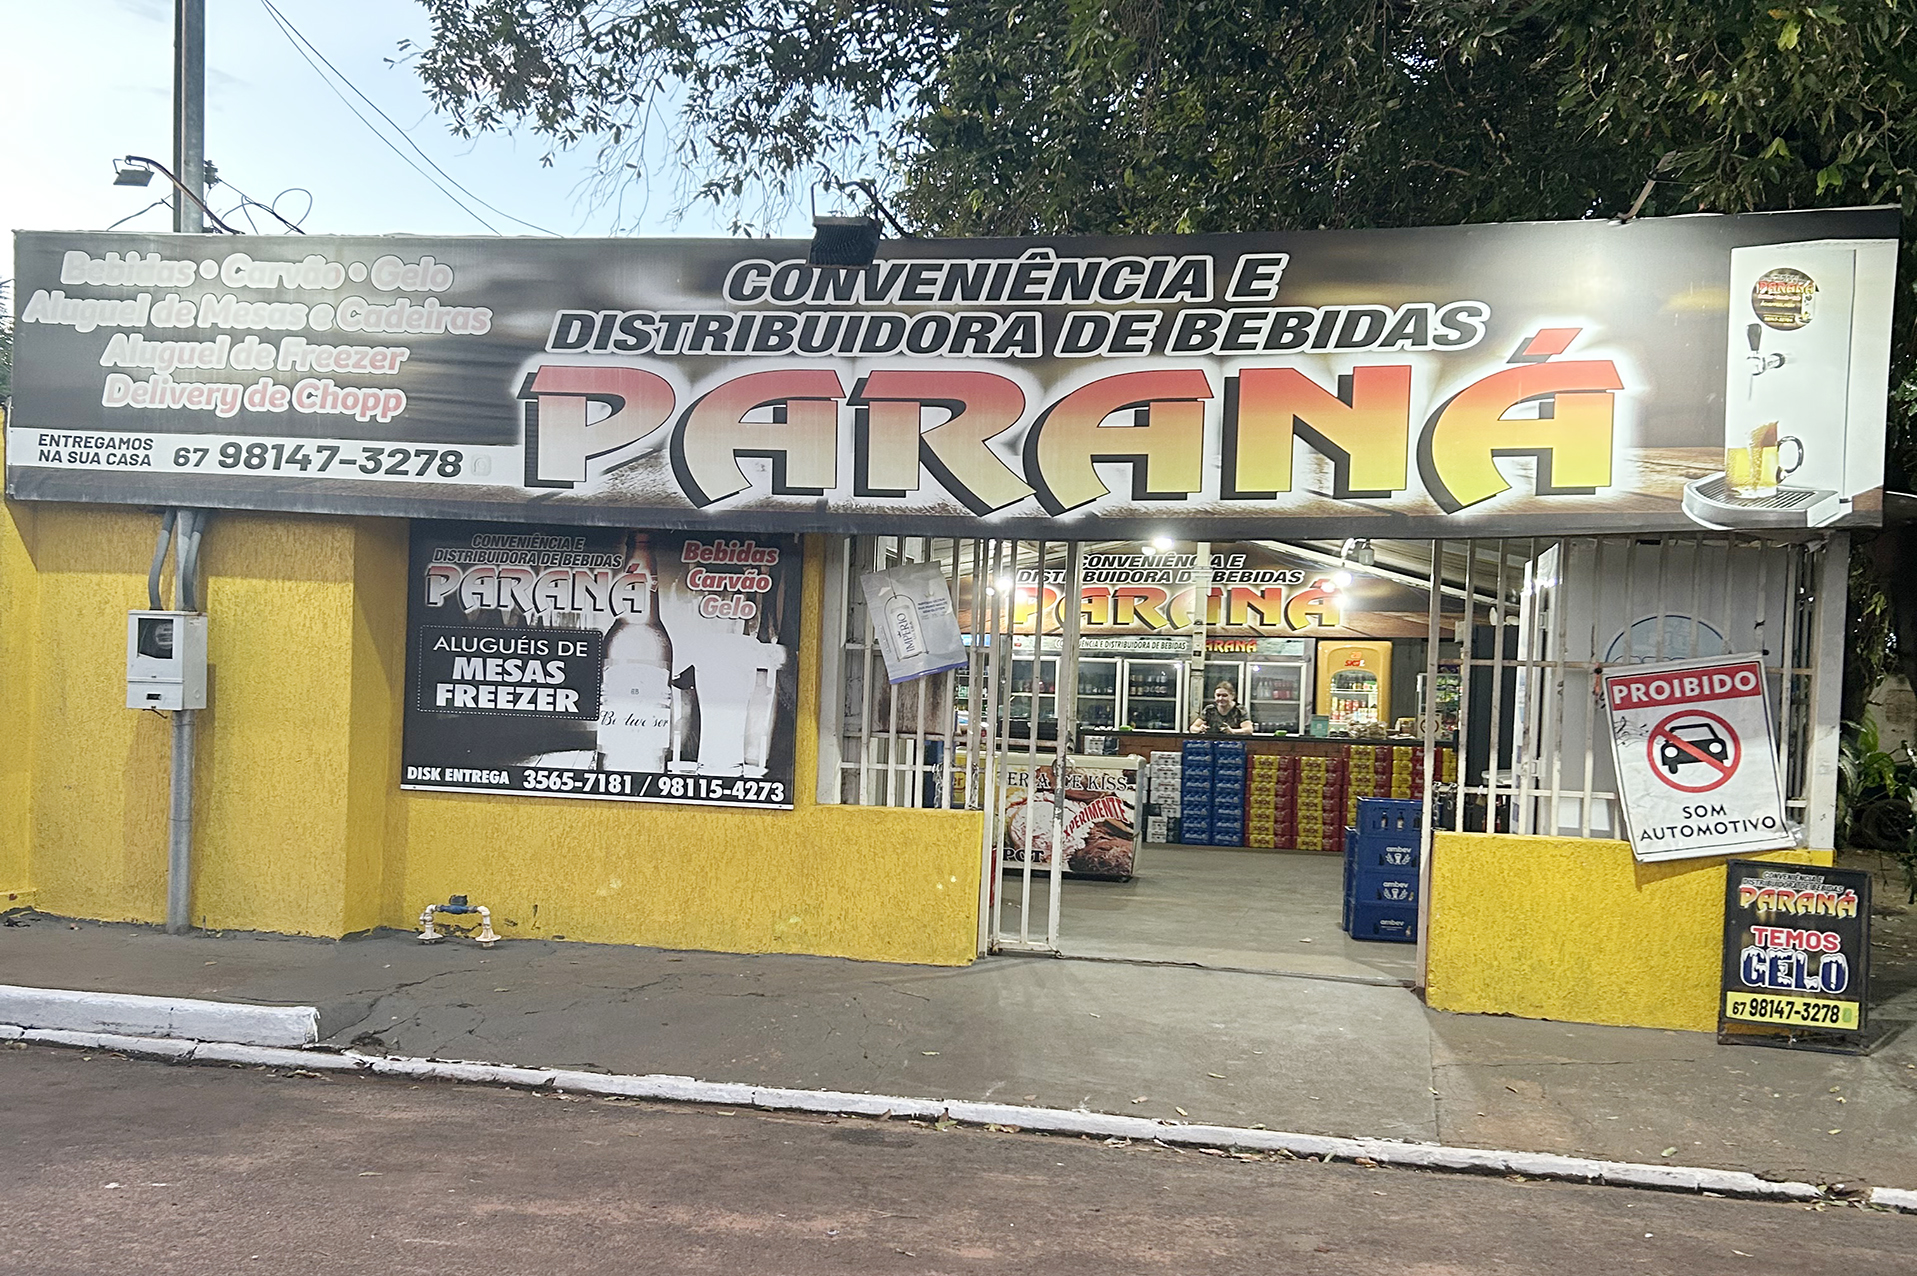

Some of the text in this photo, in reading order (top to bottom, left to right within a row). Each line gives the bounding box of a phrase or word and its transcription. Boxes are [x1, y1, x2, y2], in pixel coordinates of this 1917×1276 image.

[61, 251, 454, 291] Bebidas Carvão Gelo
[724, 247, 1290, 306] CONVENIÊNCIA E
[22, 290, 493, 335] Aluguel de Mesas e Cadeiras
[545, 301, 1492, 357] DISTRIBUIDORA DE BEBIDAS
[100, 334, 410, 375] Aluguel de Freezer
[102, 373, 406, 422] Delivery de Chopp
[516, 327, 1625, 517] PARANÁ
[38, 434, 154, 450] ENTREGAMOS
[38, 449, 152, 467] NA SUA CASA
[173, 442, 463, 477] 67 98147-3278
[472, 534, 585, 550] CONVENIÊNCIA E
[681, 540, 779, 565] Bebidas
[433, 548, 623, 568] DISTRIBUIDORA DE BEBIDAS
[1083, 551, 1246, 568] ONVENIÊNCA E
[425, 563, 650, 617] PARANÁ
[686, 568, 772, 593] Carvão
[1017, 570, 1172, 583] DISTBUIDORA
[1211, 570, 1305, 584] BEBIDAS
[699, 595, 756, 621] Gelo
[433, 635, 588, 657] ALUGUÉIS DE
[1205, 639, 1257, 653] ARANÁ
[452, 657, 566, 684] MESAS
[436, 683, 580, 713] FREEZER
[1612, 671, 1757, 704] PROIBIDO
[407, 766, 441, 781] DISK
[444, 768, 510, 784] ENTREGA
[523, 770, 633, 794] 3565-7181
[657, 777, 785, 802] 98115-4273
[1087, 775, 1128, 791] KISS
[1063, 796, 1129, 838] XPERIMENTE
[1683, 804, 1727, 820] SOM
[1640, 816, 1776, 842] AUTOMOTIVO
[1386, 846, 1412, 854] ambev
[1382, 881, 1409, 889] ambev
[1739, 885, 1858, 919] PARANÁ
[1380, 919, 1405, 927] ambev
[1751, 926, 1841, 952] TEMOS
[1741, 946, 1849, 993] GELO
[1732, 998, 1840, 1023] 67 98147-3278
